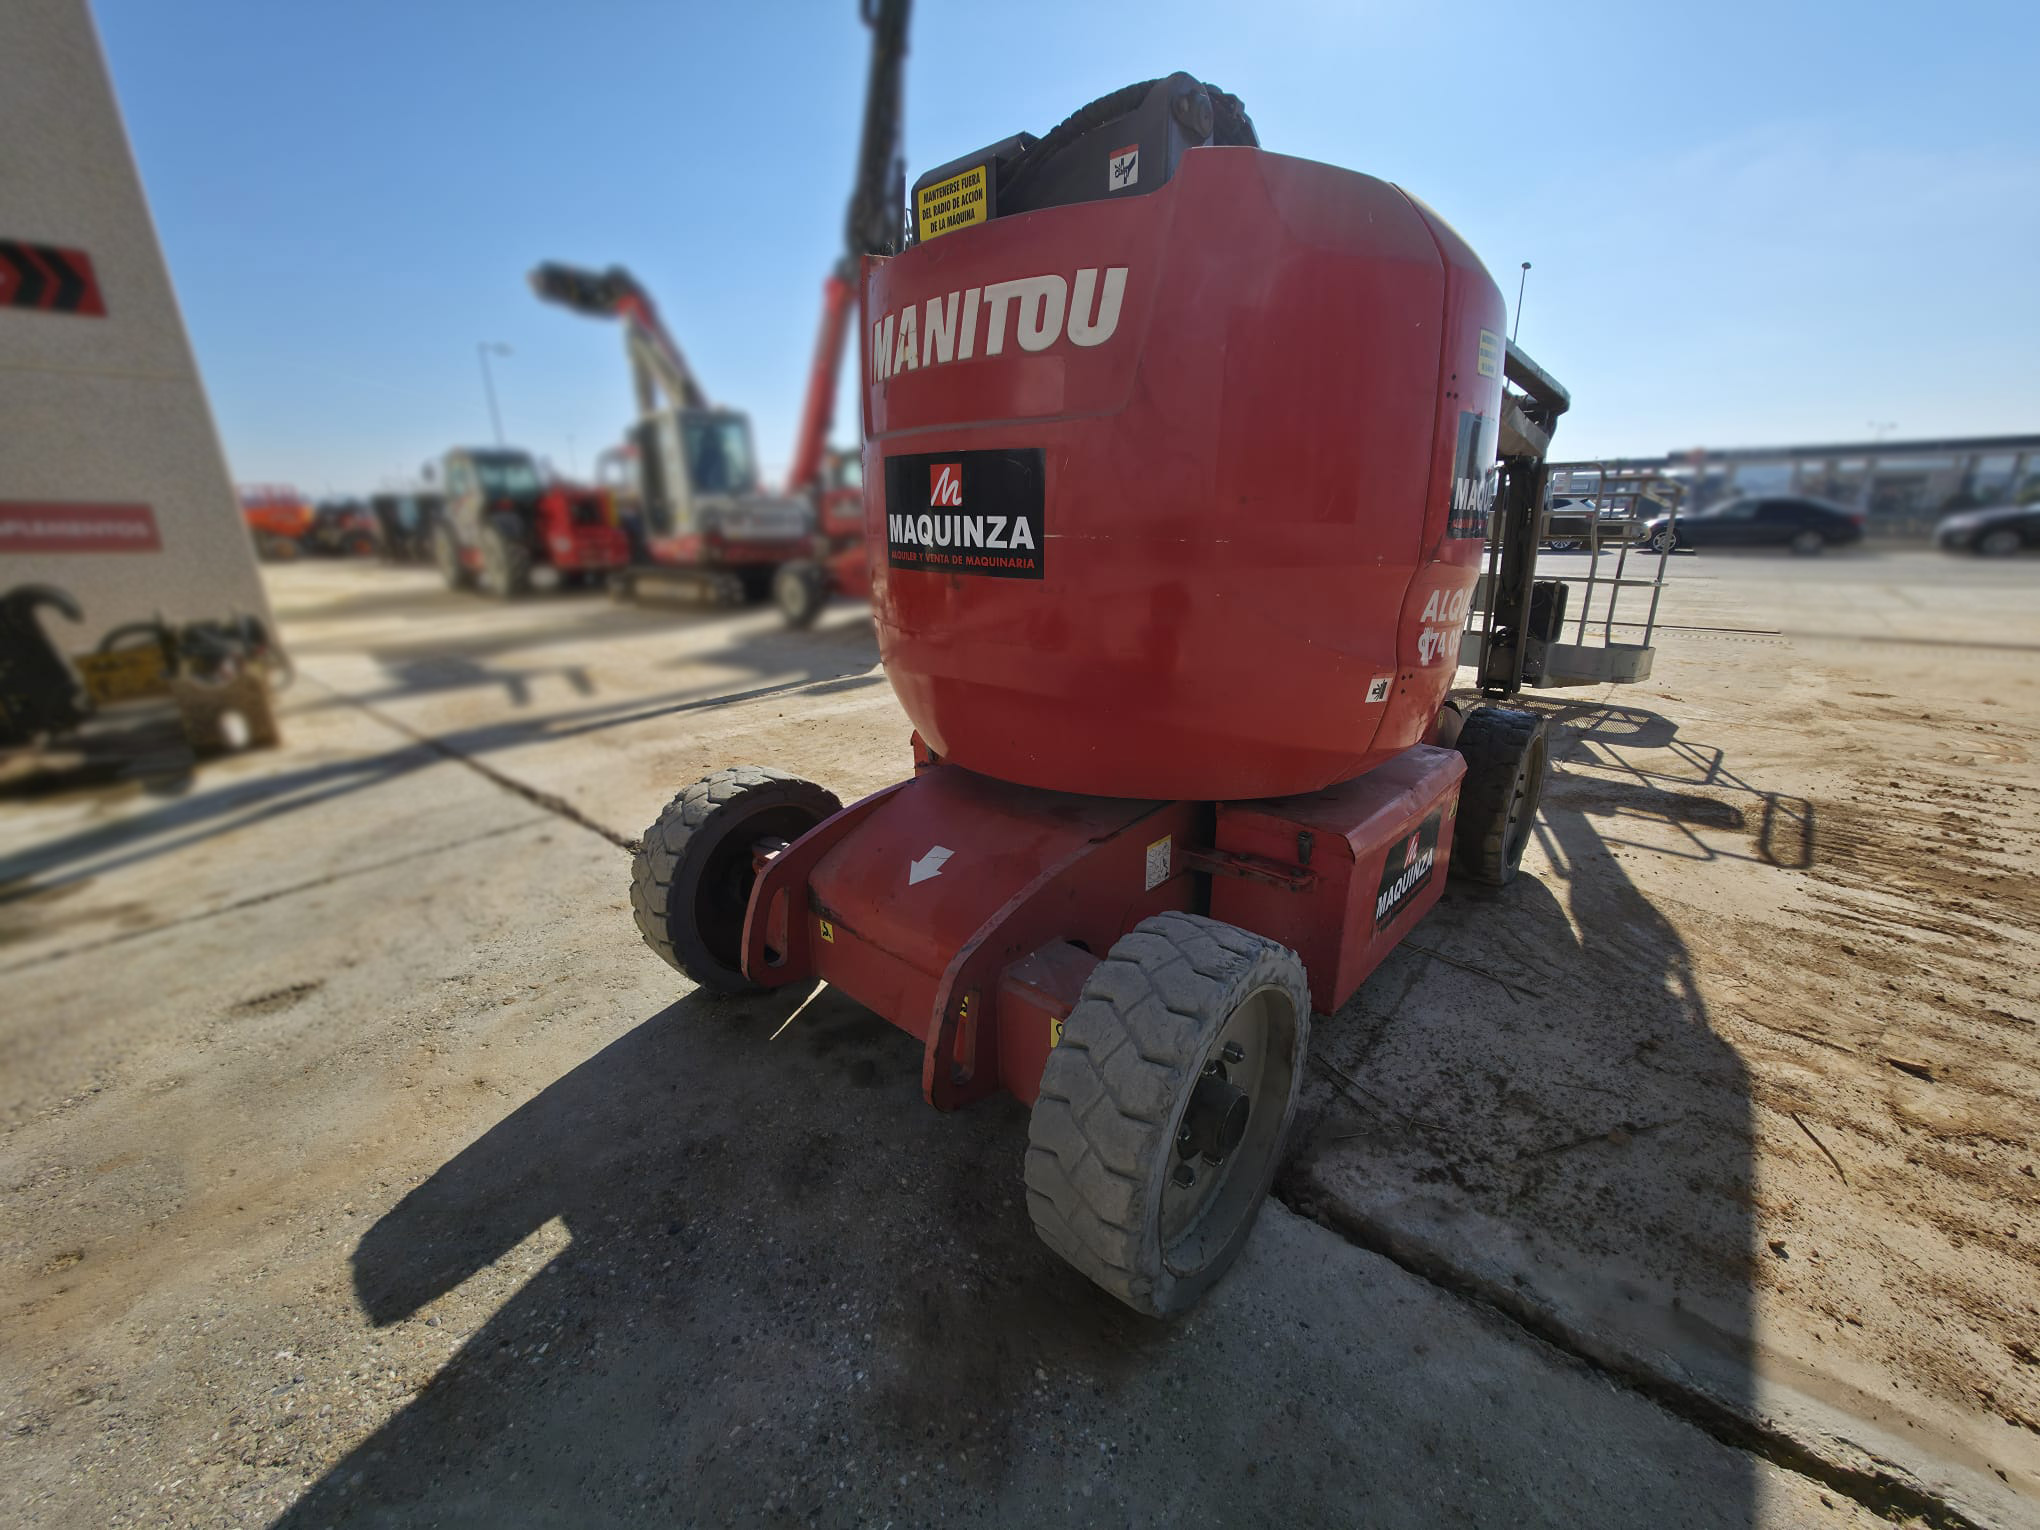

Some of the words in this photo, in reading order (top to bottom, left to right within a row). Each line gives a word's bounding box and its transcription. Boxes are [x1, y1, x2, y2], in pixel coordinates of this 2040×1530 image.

[923, 181, 960, 205] MANTENERSE
[961, 172, 981, 189] FUERA
[922, 207, 932, 220] DEL
[933, 199, 951, 217] RADIO
[952, 197, 960, 210] DE
[930, 222, 938, 233] DE
[938, 218, 946, 230] LA
[947, 207, 976, 228] MAQUINA
[872, 267, 1129, 385] MANITOU
[889, 514, 1036, 550] MAQUINZA
[891, 551, 917, 561] ALQUILER
[919, 552, 924, 561] Y
[926, 553, 950, 565] VENTA
[952, 555, 963, 565] DE
[965, 556, 1035, 569] MAQUINARIA
[1376, 848, 1433, 920] MAQUINZA
